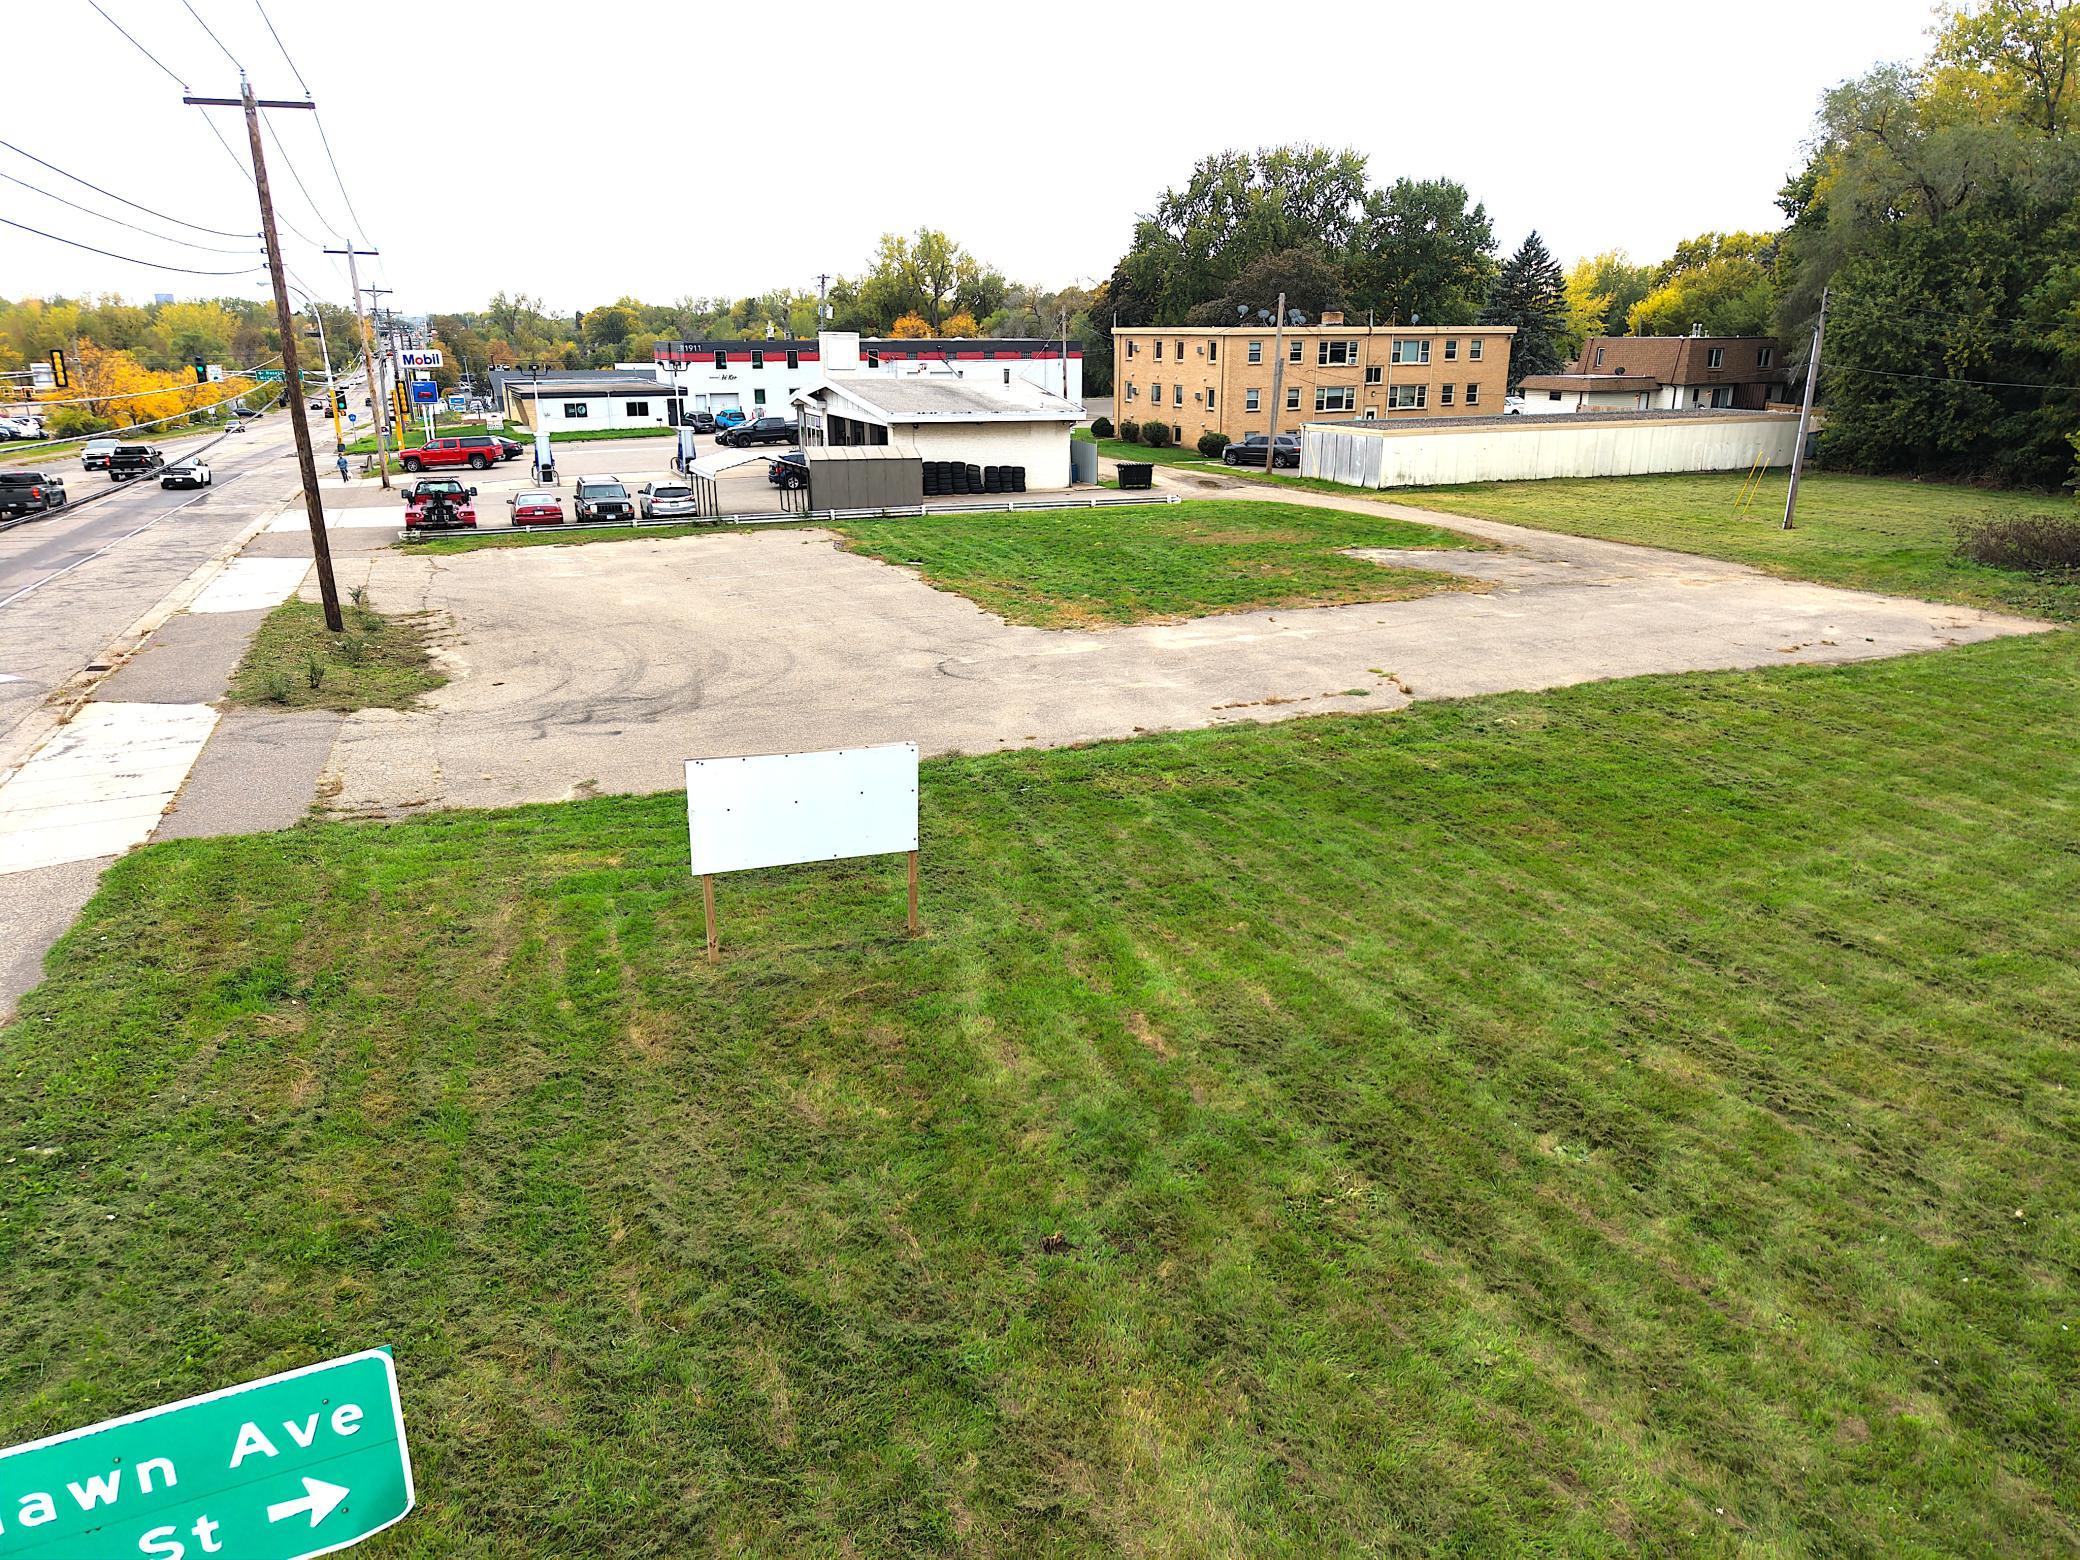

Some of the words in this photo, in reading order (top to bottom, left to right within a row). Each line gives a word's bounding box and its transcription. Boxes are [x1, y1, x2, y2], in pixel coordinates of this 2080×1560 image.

[402, 353, 440, 365] Mobil
[684, 344, 702, 352] 1911
[0, 1457, 178, 1535] awn
[229, 1403, 364, 1469] Ave
[138, 1514, 223, 1560] St
